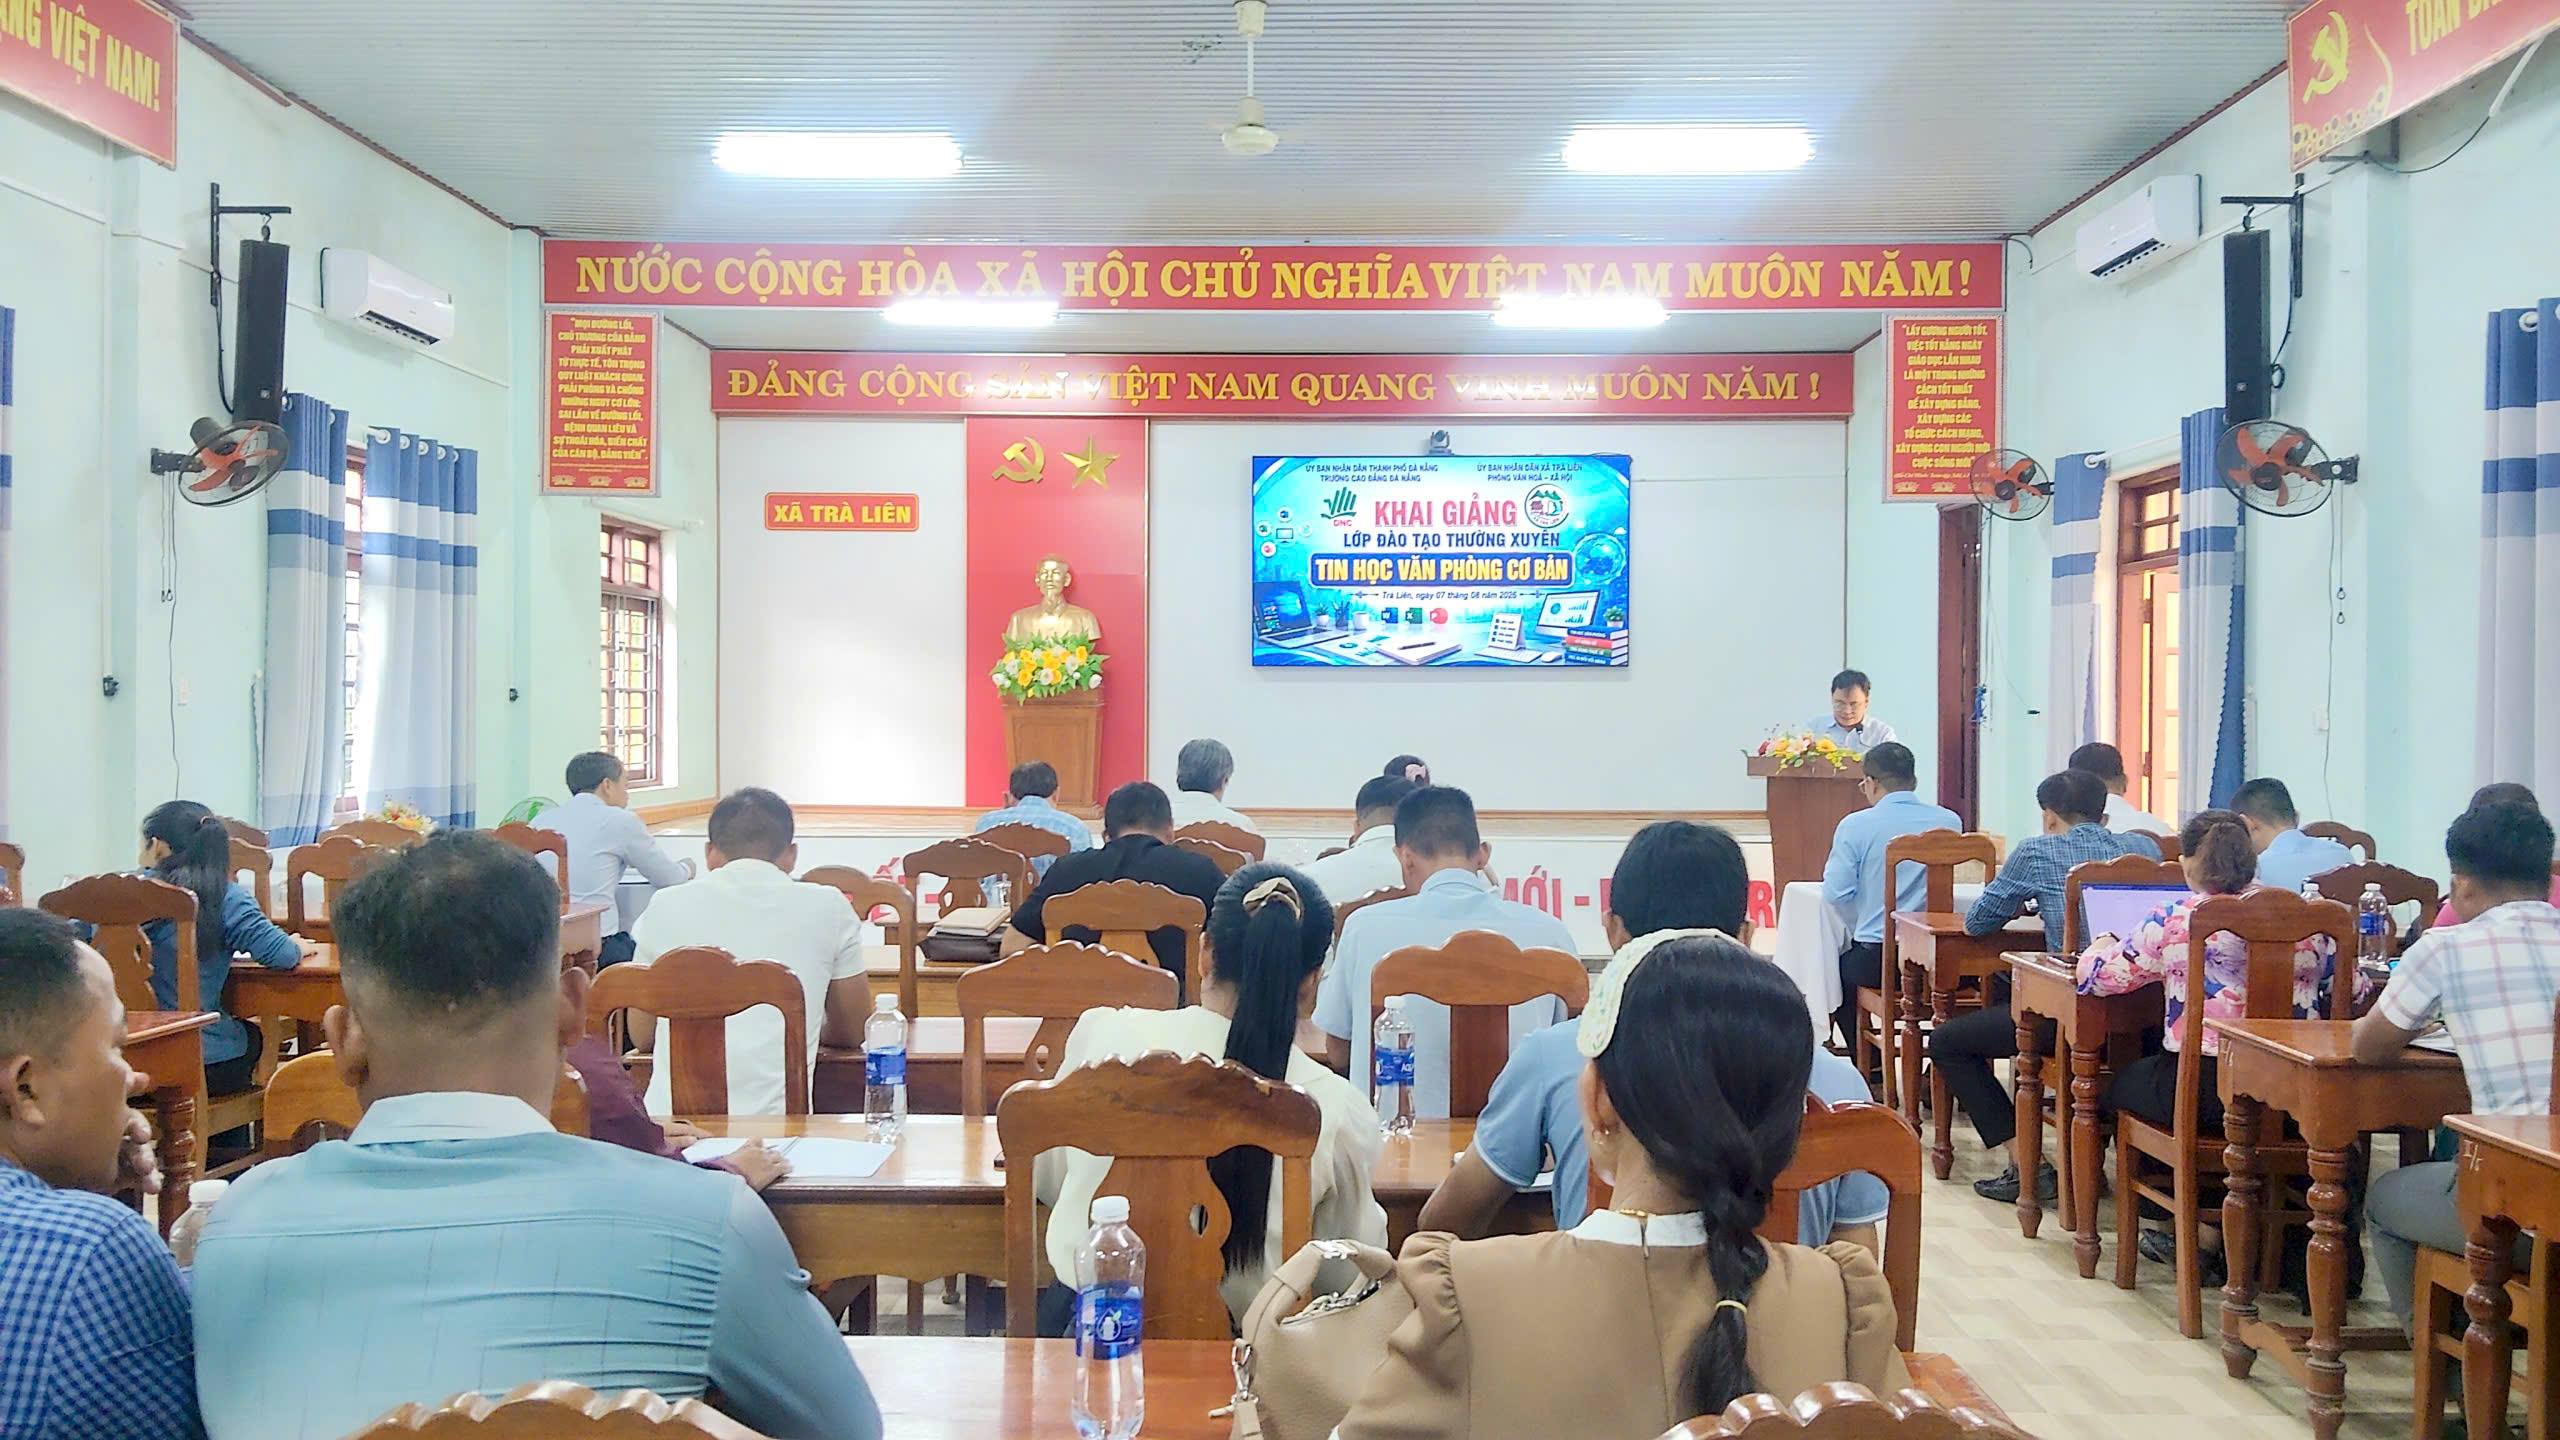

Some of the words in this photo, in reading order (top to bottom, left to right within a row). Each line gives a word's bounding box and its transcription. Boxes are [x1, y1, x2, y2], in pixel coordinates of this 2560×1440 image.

[50, 2, 101, 85] VIỆT
[105, 34, 160, 112] NAM!
[576, 250, 703, 297] NƯỚC
[714, 247, 846, 304] CỘNG
[858, 248, 960, 298] HÒA
[975, 249, 1043, 298] XÃ
[1063, 247, 1153, 306] HỘI
[1159, 247, 1260, 298] CHỦ
[1274, 252, 1429, 299] NGHĨA
[1428, 253, 1547, 308] VIỆT
[1562, 262, 1673, 298] NAM
[1685, 254, 1823, 298] MUÔN
[1840, 251, 1972, 298] NĂM!
[728, 358, 848, 399] ĐẢNG
[860, 363, 975, 406] CỘNG
[1082, 364, 1176, 407] VIỆT
[1187, 371, 1278, 400] NAM
[1291, 372, 1434, 402] QUANG
[1563, 364, 1690, 401] MUÔN
[1702, 366, 1800, 401] NĂM
[774, 501, 803, 522] XÃ
[810, 501, 854, 523] TRÀ
[861, 502, 912, 524] LIÊN
[1375, 500, 1433, 526] KHAI
[1442, 492, 1517, 526] GIẢNG
[1344, 530, 1371, 548] LỚP
[1377, 530, 1407, 548] ĐÀO
[1413, 533, 1441, 550] TẠO
[1446, 530, 1505, 548] THƯỜNG
[1511, 529, 1560, 547] XUYÊN
[1315, 559, 1348, 581] TIN
[1352, 559, 1393, 585] HỌC
[1398, 554, 1436, 581] VĂN
[1439, 554, 1502, 581] PHÒNG
[1506, 557, 1531, 581] CƠ
[1533, 554, 1568, 581] BẢN
